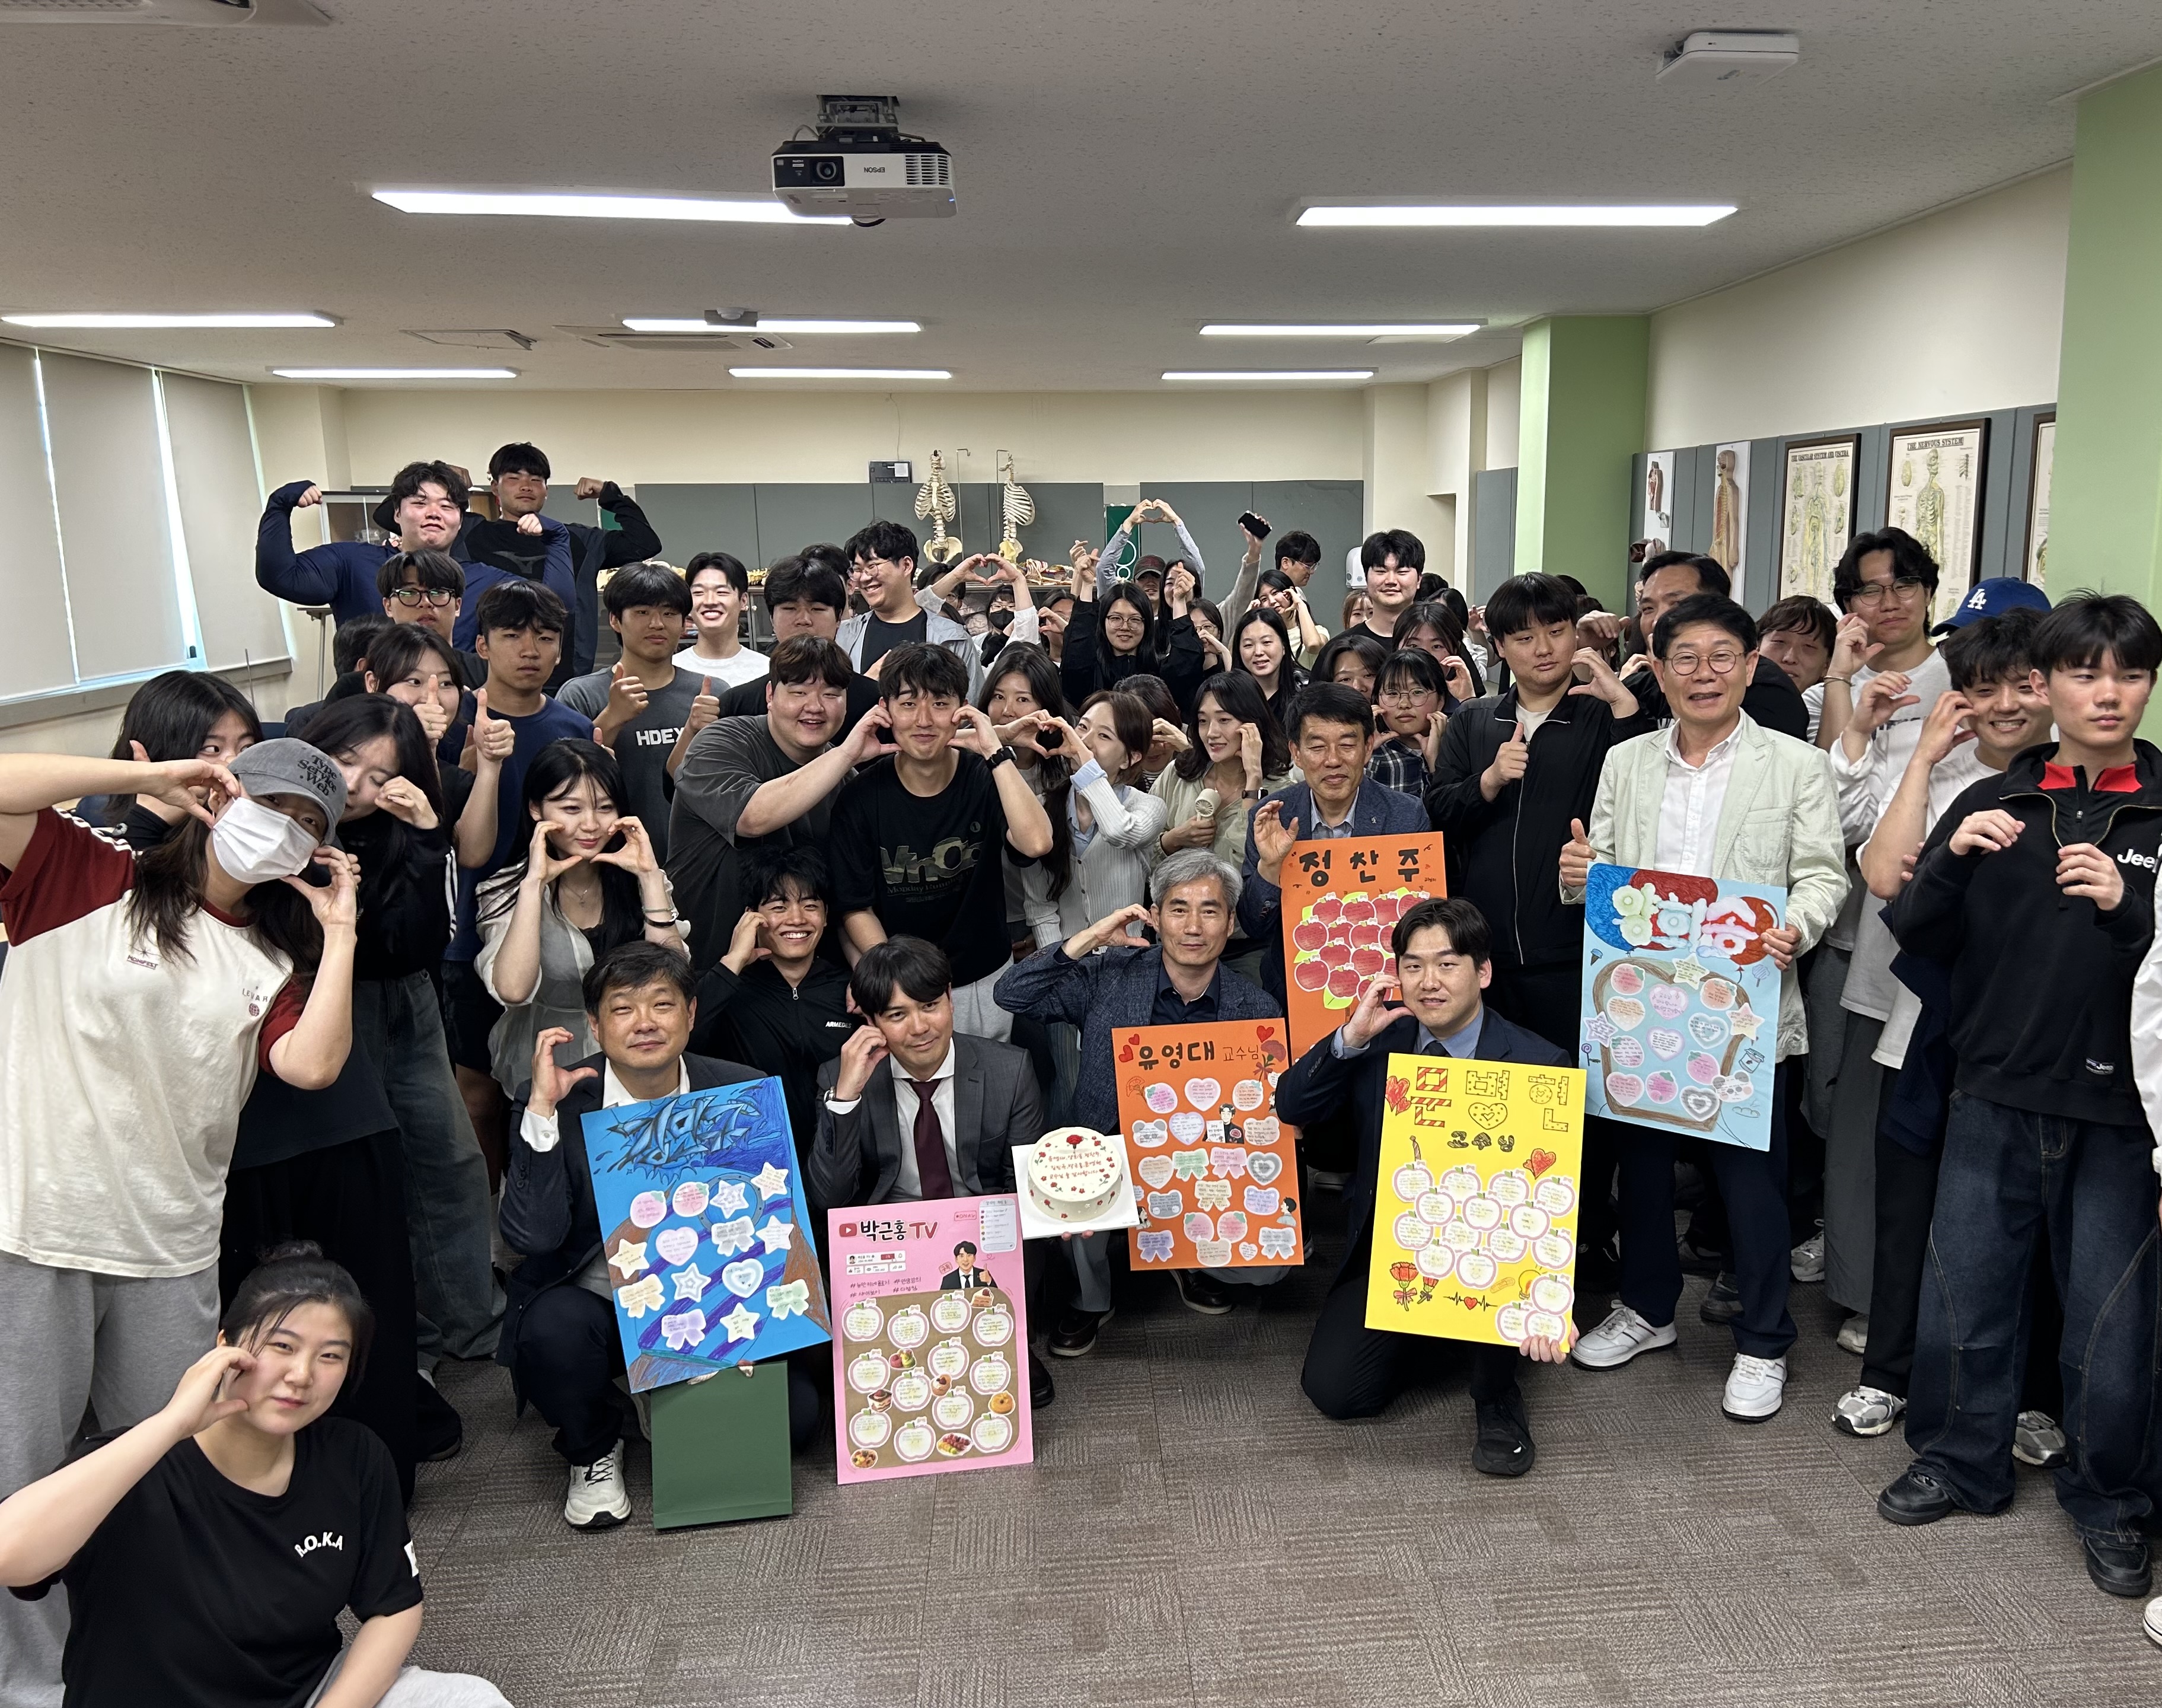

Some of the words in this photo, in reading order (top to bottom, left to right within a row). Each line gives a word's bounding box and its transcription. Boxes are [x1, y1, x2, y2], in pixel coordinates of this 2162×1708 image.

[1907, 442, 1917, 451] THE
[1918, 439, 1941, 449] NERVOUS
[1942, 436, 1964, 446] SYSTEM
[1967, 588, 1987, 610] LA
[297, 759, 337, 792] Service
[311, 755, 337, 780] Type
[1138, 1040, 1215, 1070] 유영대
[1222, 1046, 1261, 1062] 교수님
[860, 1220, 907, 1242] 박근홍
[908, 1221, 938, 1239] TV
